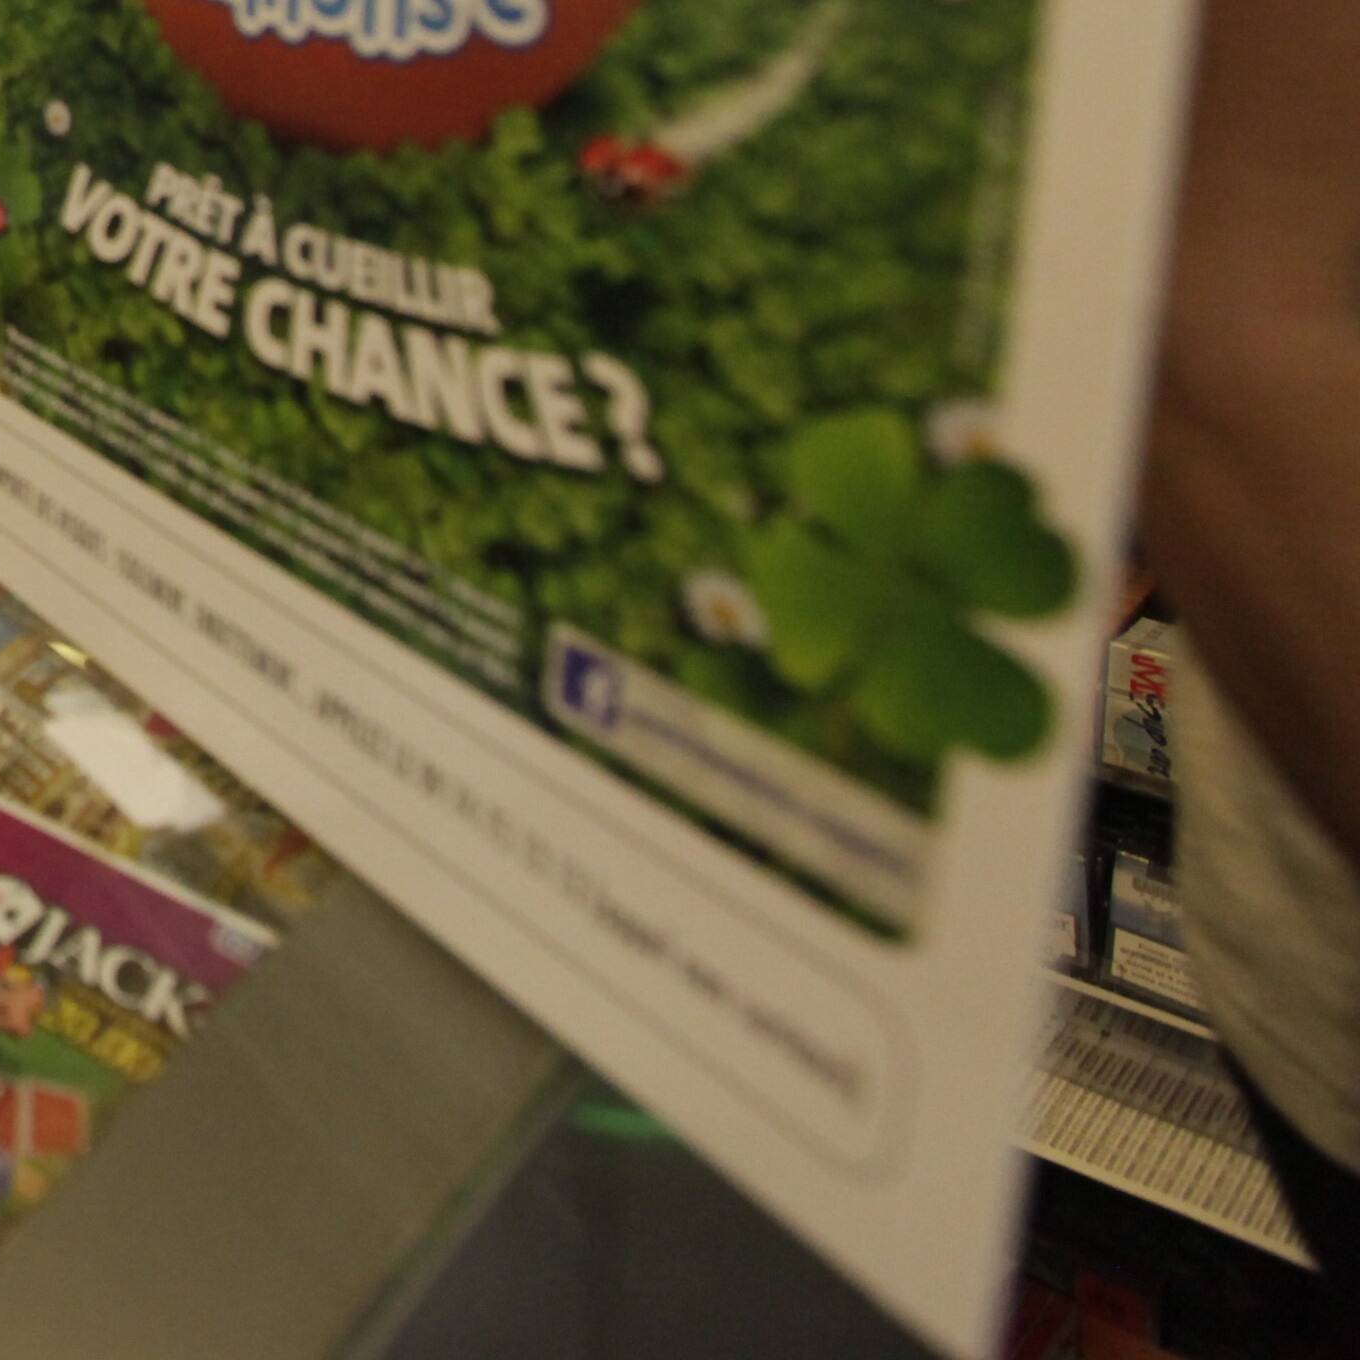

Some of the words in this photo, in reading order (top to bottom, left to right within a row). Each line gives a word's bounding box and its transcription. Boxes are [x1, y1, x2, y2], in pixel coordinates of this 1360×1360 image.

[58, 162, 244, 339] VOTRE
[144, 160, 245, 232] PRÊT
[240, 191, 280, 268] À
[282, 222, 503, 336] CUEILLIR
[20, 906, 212, 1040] JACK
